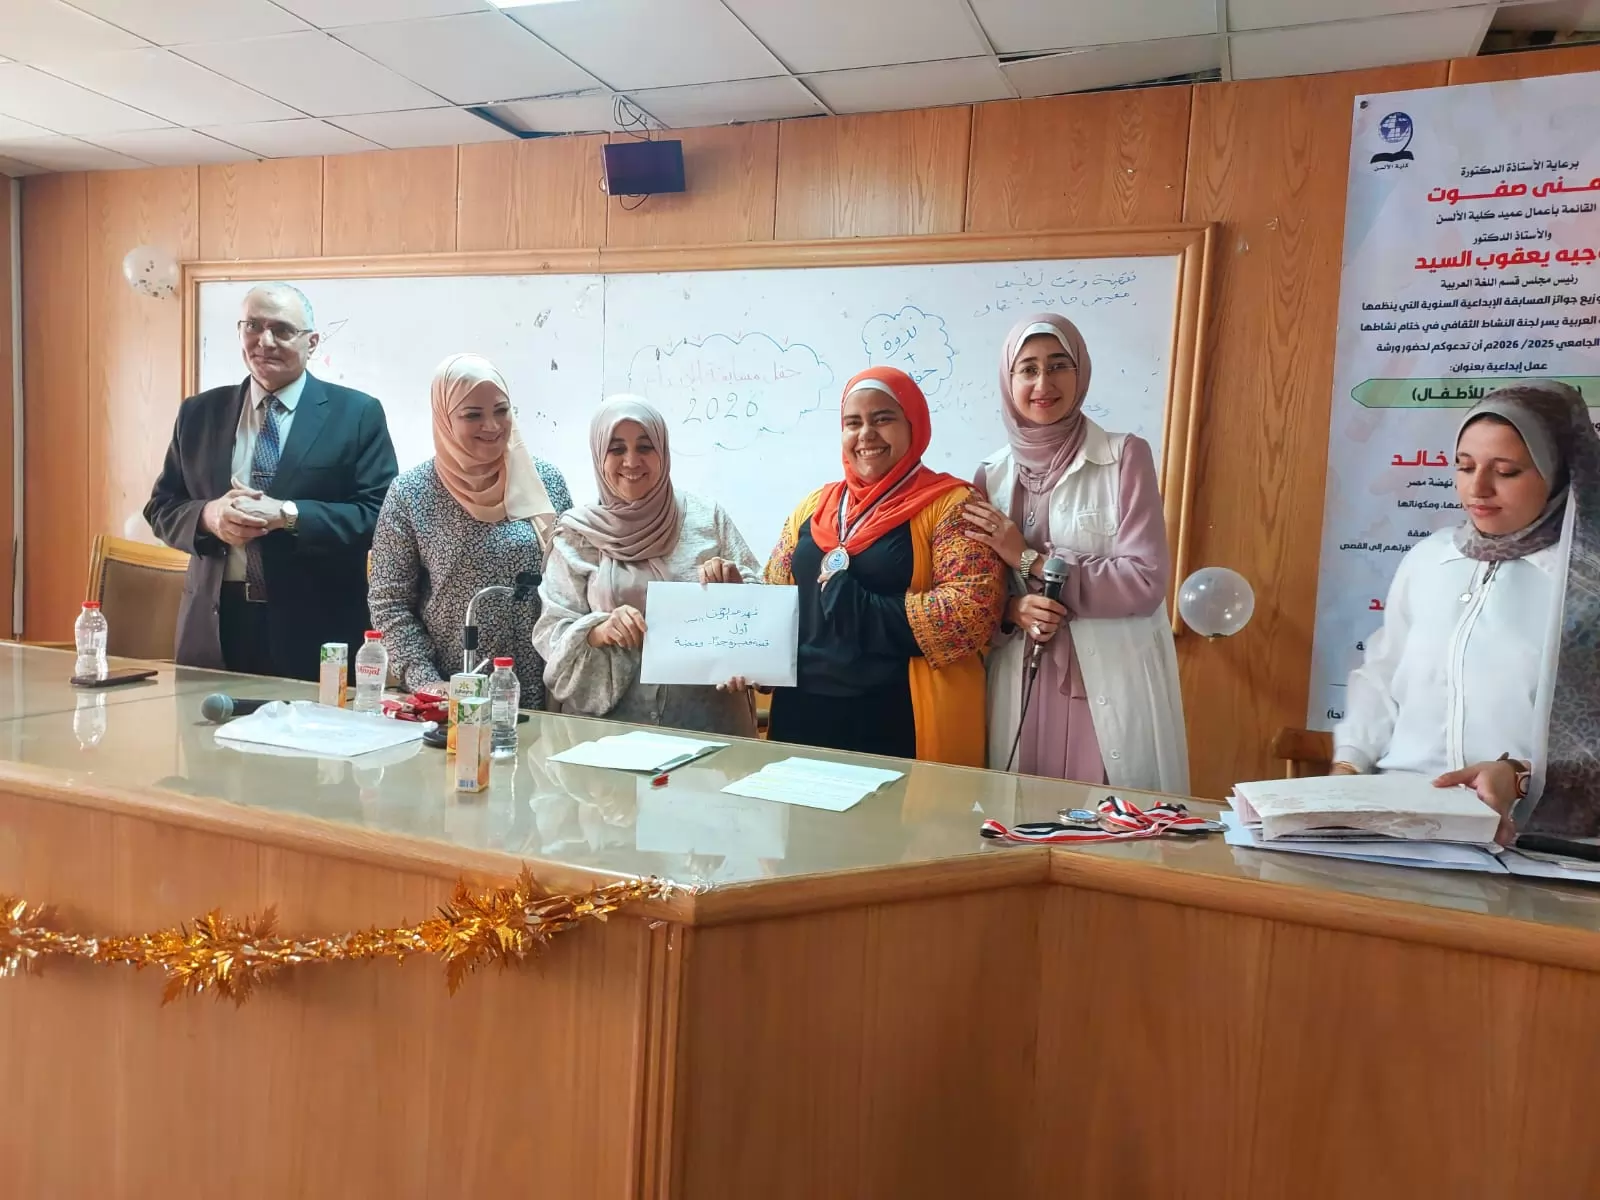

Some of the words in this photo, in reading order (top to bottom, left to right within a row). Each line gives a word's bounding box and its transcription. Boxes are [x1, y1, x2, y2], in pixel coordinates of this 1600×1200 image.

[1460, 163, 1505, 178] الدكتورة
[1506, 158, 1544, 173] الأستاذة
[1546, 158, 1580, 171] برعاية
[1498, 208, 1523, 219] عميد
[1525, 204, 1560, 219] بأعمال
[1561, 202, 1597, 214] القائمة
[1436, 210, 1467, 225] الألسن
[1468, 209, 1496, 222] كلية
[1472, 232, 1513, 245] الدكتور
[1514, 227, 1552, 241] والأستاذ
[1414, 250, 1472, 273] السيد
[1475, 247, 1550, 270] يعقوب
[1555, 247, 1600, 266] جيه
[1441, 278, 1473, 291] العربية
[1474, 278, 1497, 287] اللغة
[1498, 276, 1520, 288] قسم
[1521, 276, 1551, 288] مجلس
[1553, 274, 1579, 287] رئيس
[1420, 300, 1459, 312] السنوية
[1460, 297, 1503, 312] الإبداعية
[1504, 295, 1551, 308] المسابقة
[1552, 294, 1578, 306] جوائز
[1362, 302, 1398, 313] ينظمها
[1399, 301, 1419, 313] التي
[1360, 322, 1397, 333] نشاطها
[1398, 322, 1420, 333] ختام
[1422, 321, 1440, 332] في
[1441, 319, 1479, 331] الثقافي
[1481, 317, 1515, 329] النشاط
[1516, 317, 1540, 328] لجنة
[1540, 319, 1560, 329] يسر
[1562, 315, 1597, 328] العربية
[1376, 342, 1401, 353] ورشة
[1401, 342, 1431, 353] لحضور
[1431, 341, 1472, 354] تدعوكم
[1471, 339, 1483, 351] أن
[1556, 337, 1600, 351] الجامعي
[1449, 363, 1485, 373] بعنوان:
[1486, 361, 1523, 374] إبداعية
[1523, 361, 1548, 372] عمل
[1391, 449, 1449, 467] خالد
[1406, 480, 1427, 488] مصر
[1428, 477, 1453, 489] نهضة
[1397, 500, 1440, 510] ومكوناتها
[1340, 542, 1368, 550] القصص
[1369, 543, 1382, 552] إلى
